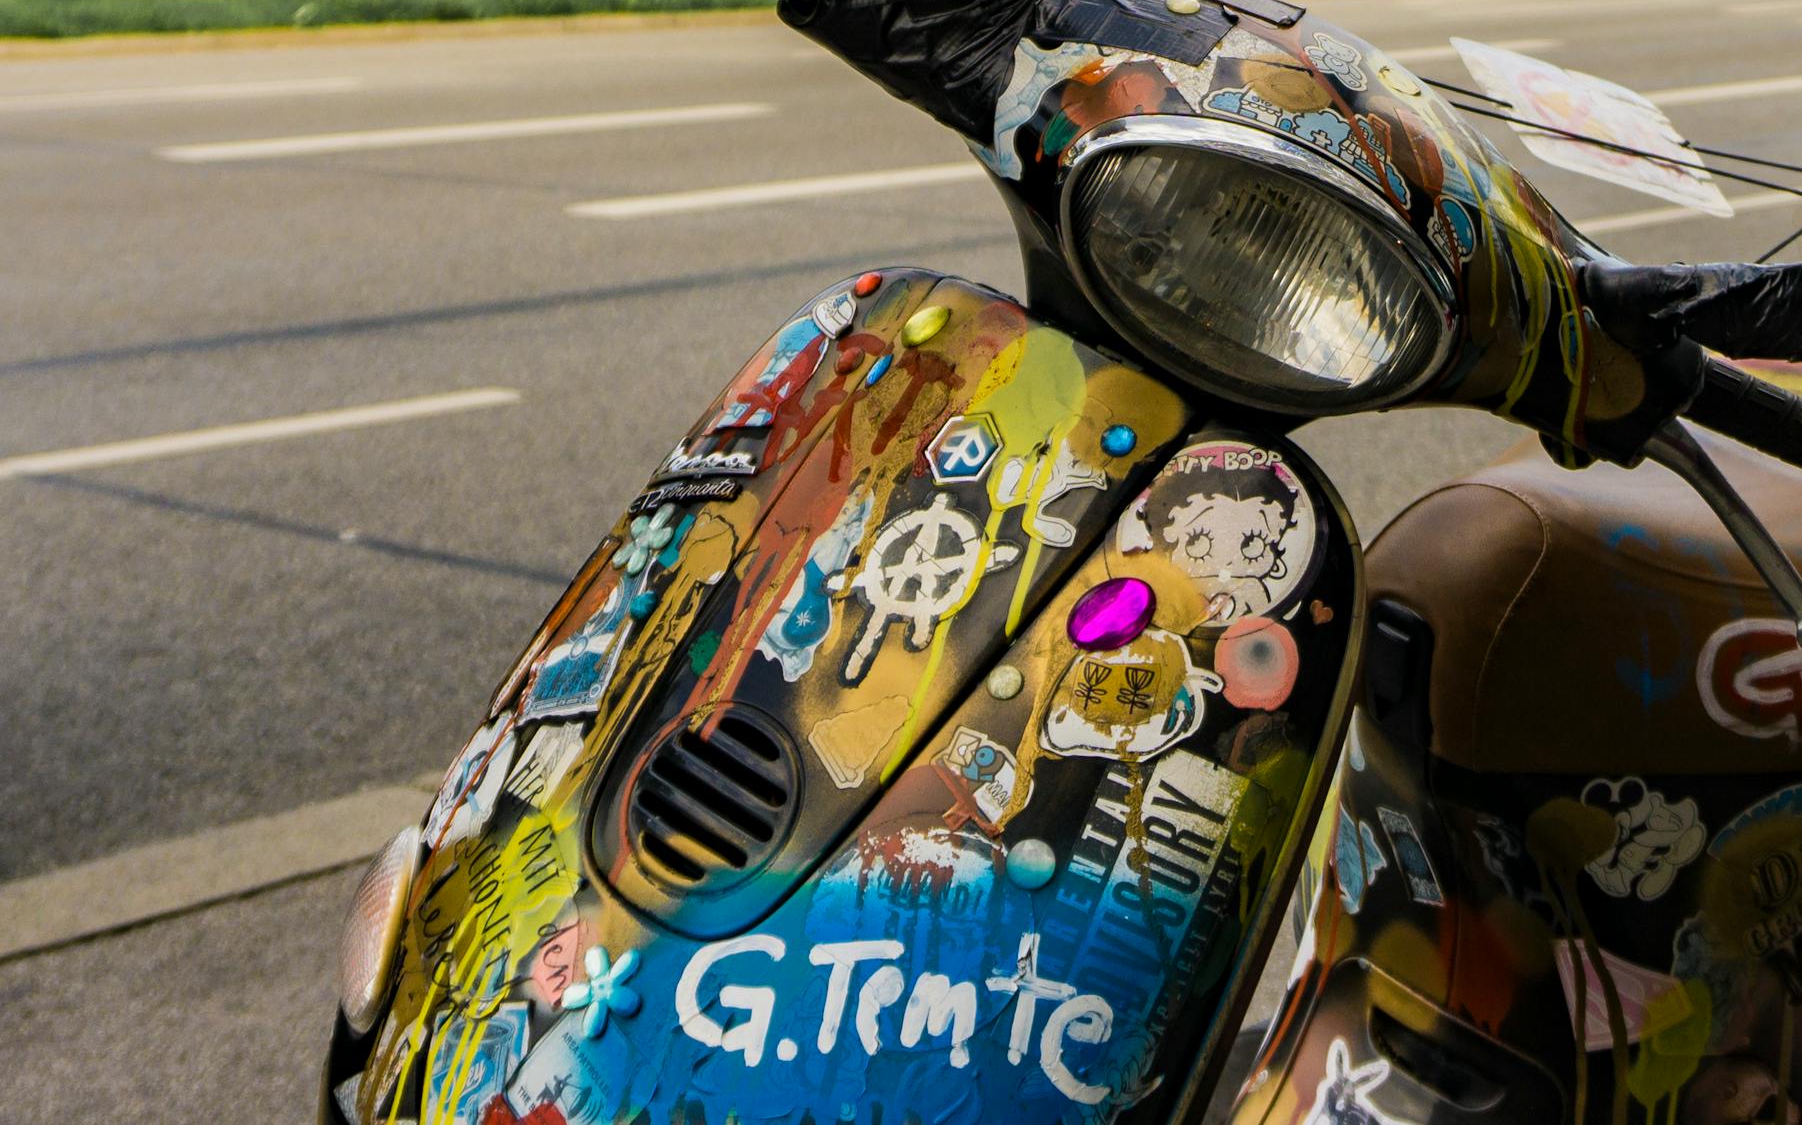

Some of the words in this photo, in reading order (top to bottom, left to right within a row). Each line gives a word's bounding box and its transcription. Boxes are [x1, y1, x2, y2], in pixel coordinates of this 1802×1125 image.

[1162, 454, 1216, 476] ETTY
[1223, 448, 1283, 471] BOOP
[518, 824, 560, 895] MIT
